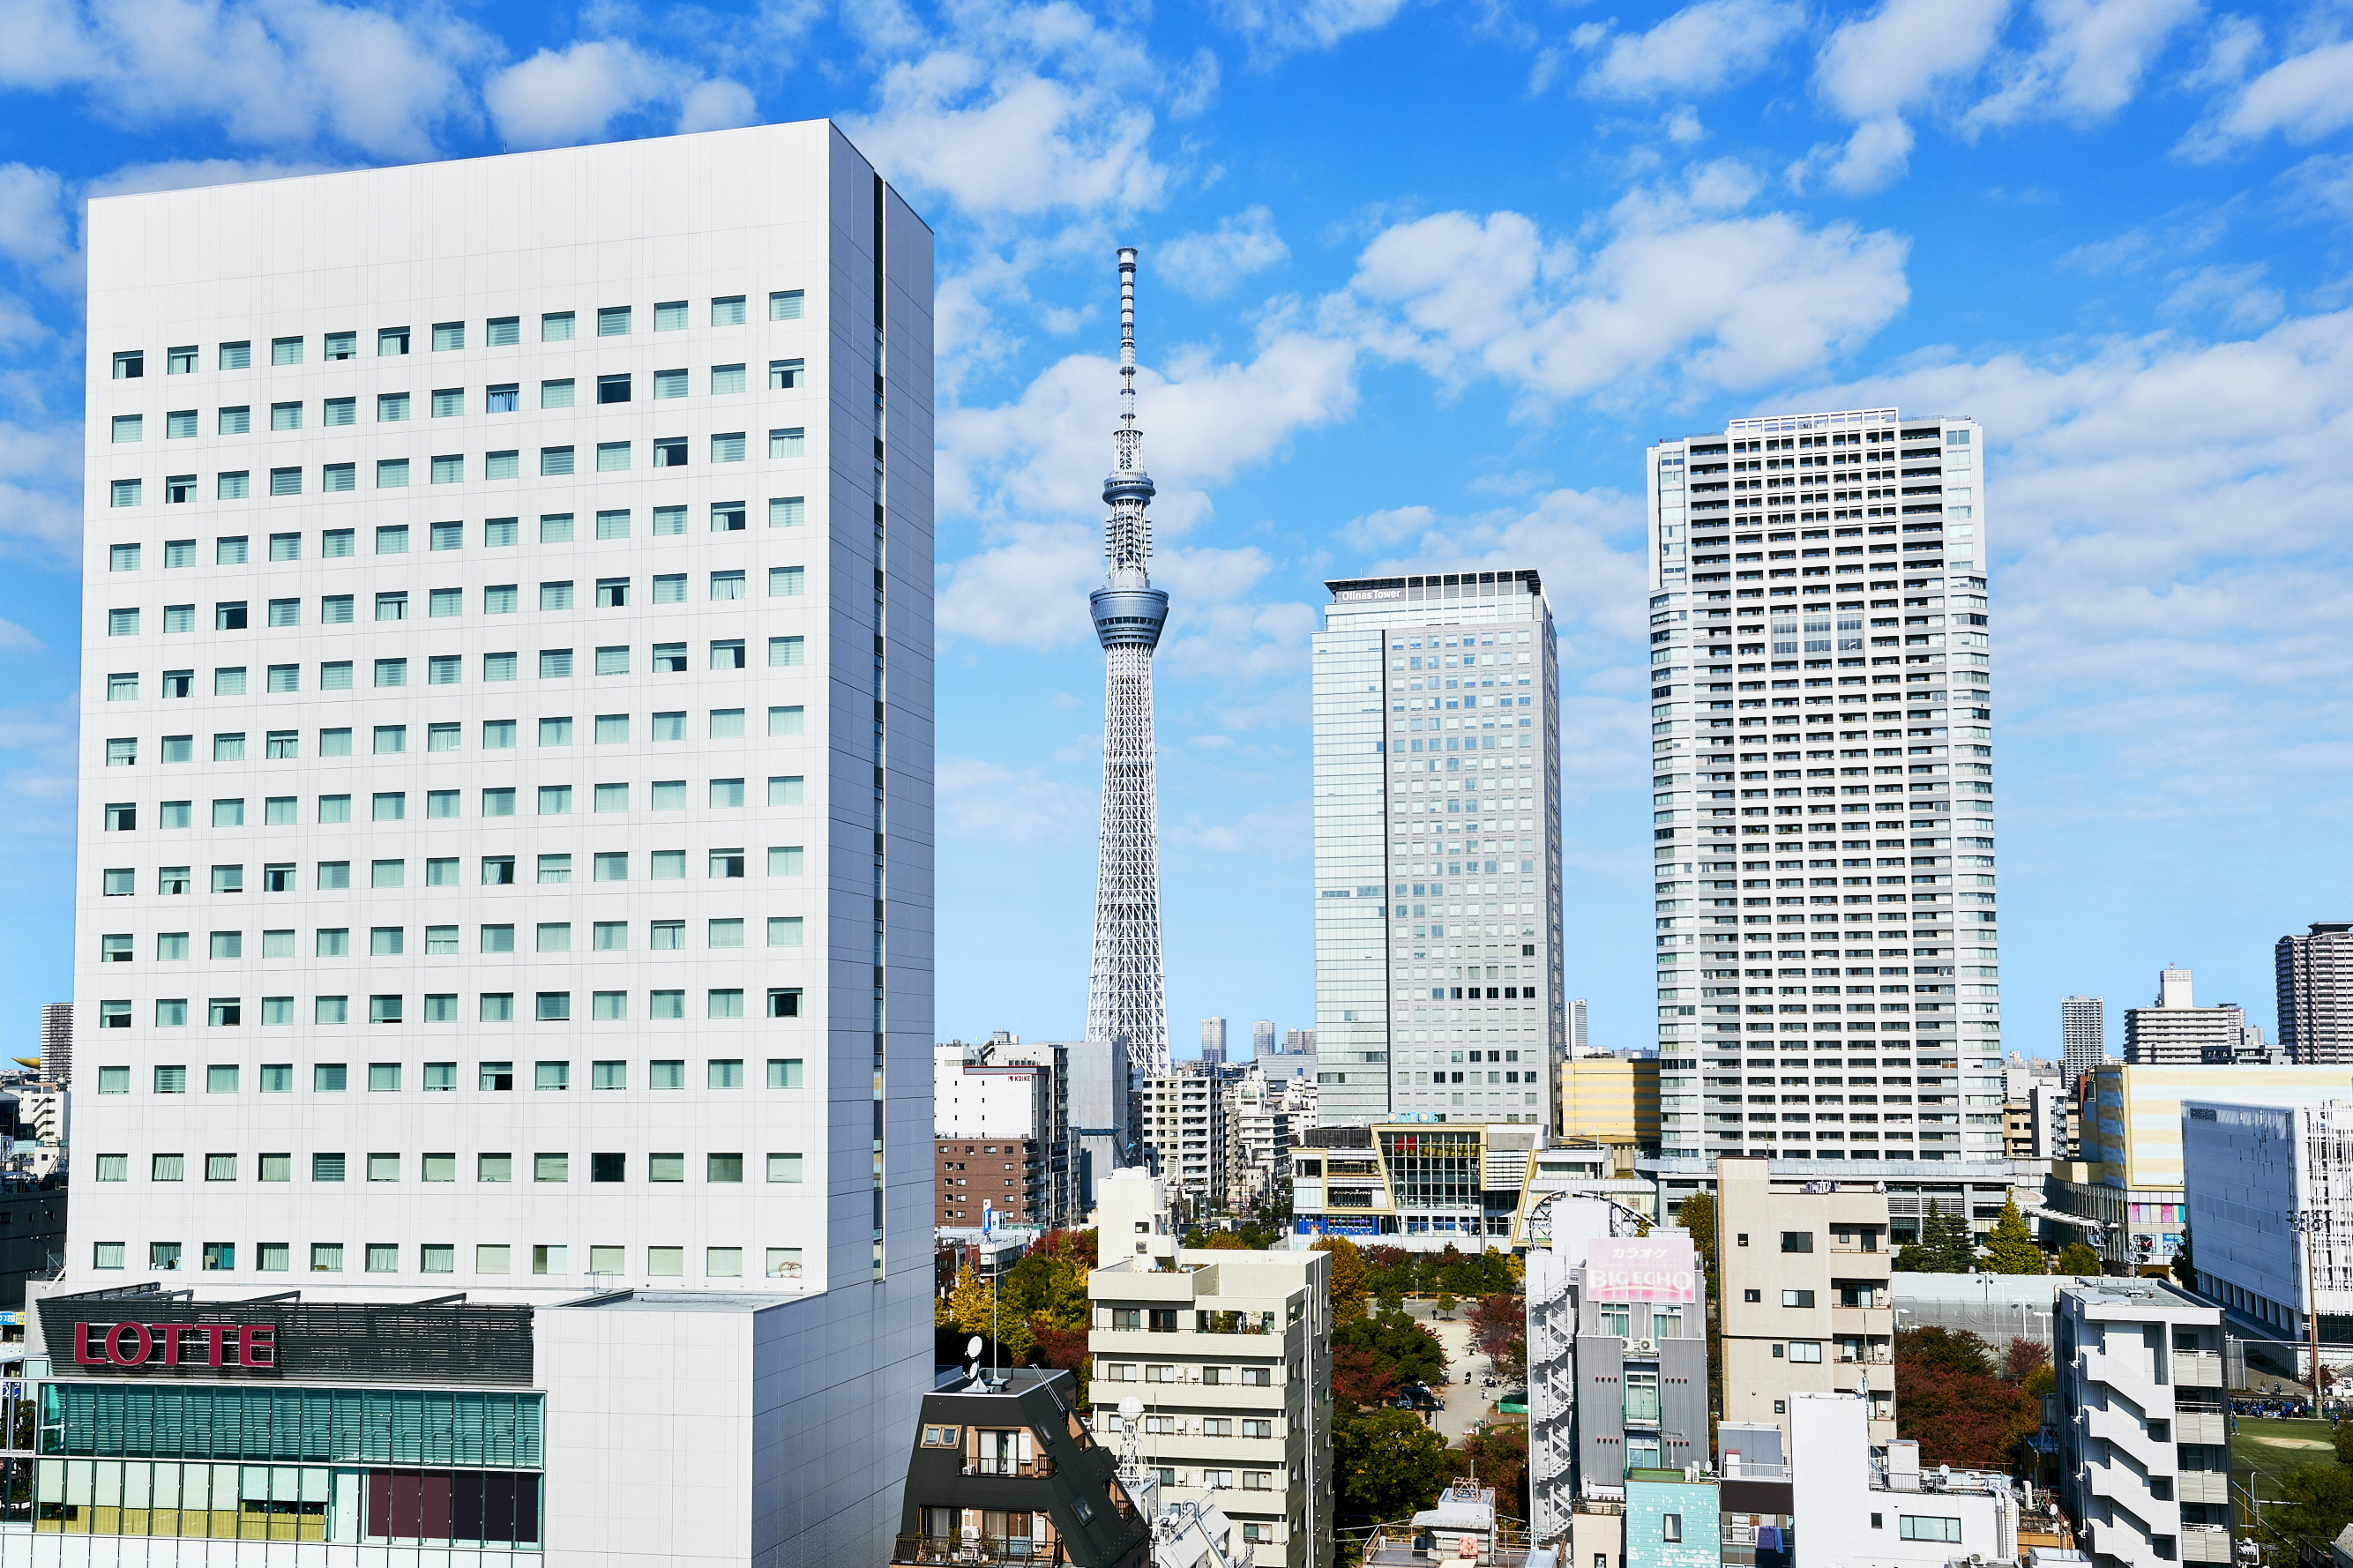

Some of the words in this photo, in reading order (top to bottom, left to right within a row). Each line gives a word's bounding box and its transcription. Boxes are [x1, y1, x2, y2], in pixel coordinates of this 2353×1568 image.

[1373, 590, 1401, 599] Tower
[1612, 1247, 1668, 1259] カラオケ
[1589, 1270, 1629, 1289] BIG
[1632, 1271, 1693, 1290] ECHO
[74, 1321, 275, 1367] LOTTE
